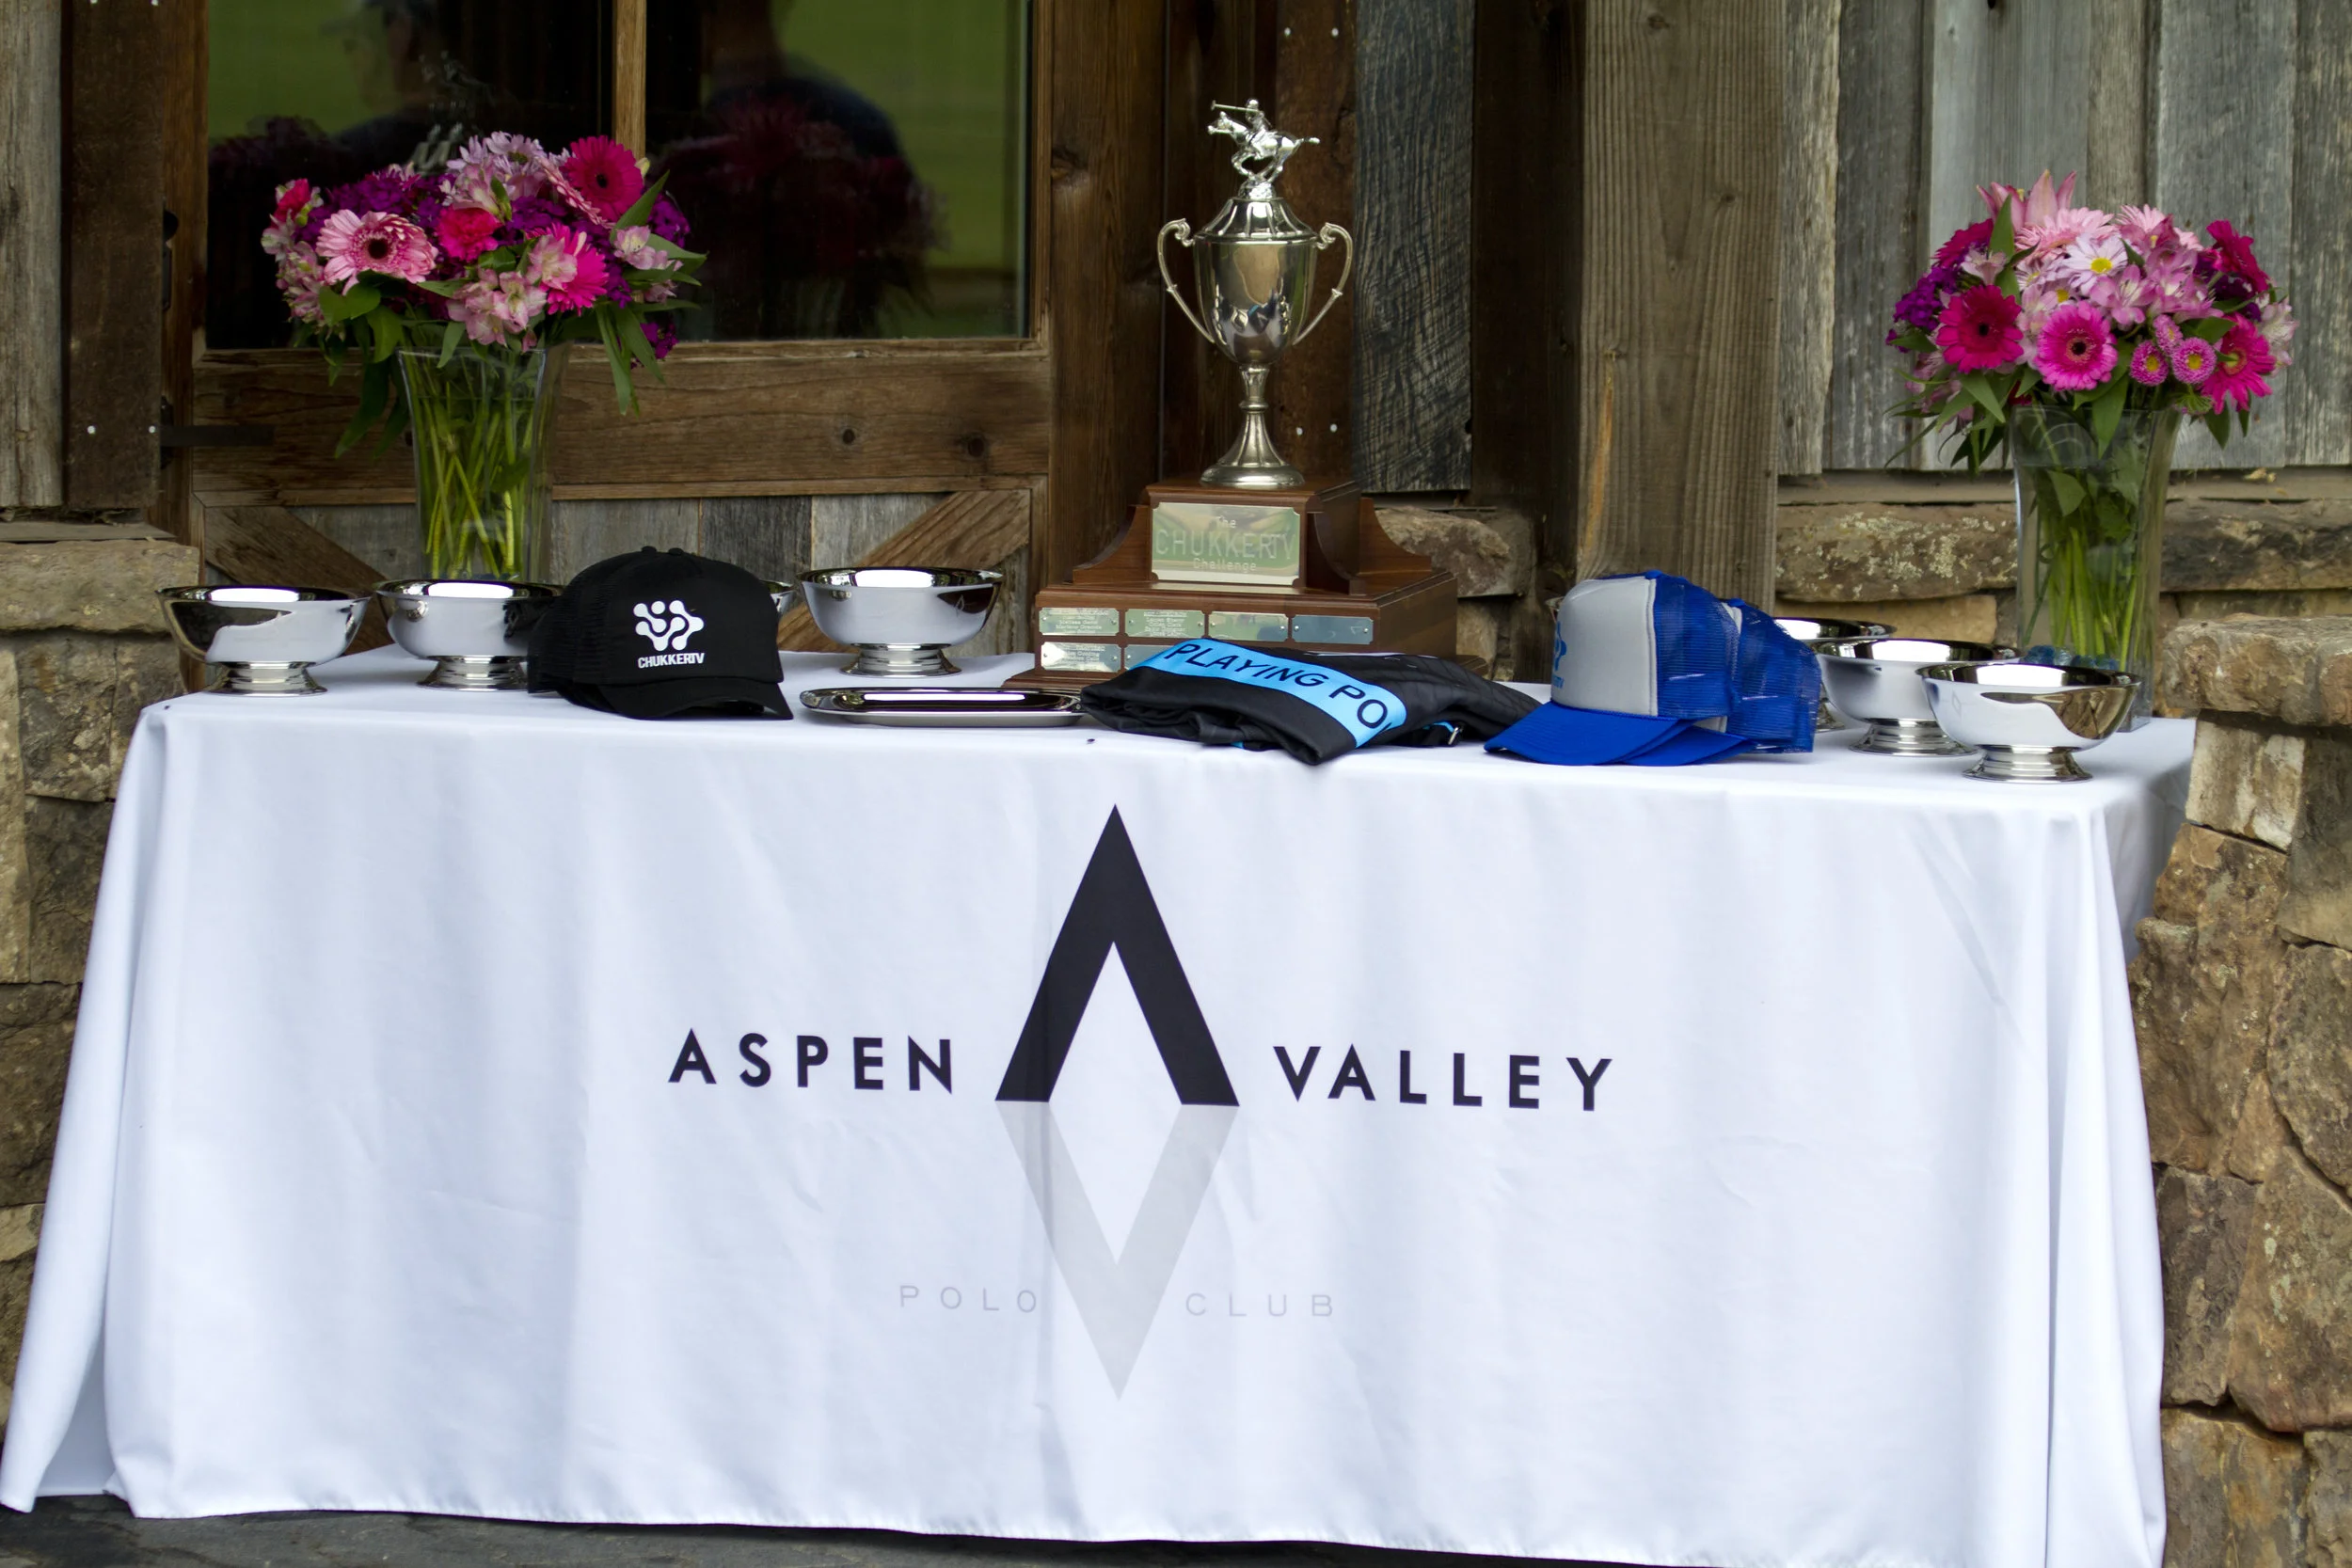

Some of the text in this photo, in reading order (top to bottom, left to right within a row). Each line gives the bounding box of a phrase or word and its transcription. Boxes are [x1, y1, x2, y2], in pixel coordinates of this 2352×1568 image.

[1216, 515, 1236, 529] The
[1192, 557, 1257, 573] Challenge
[1164, 641, 1391, 731] PLAYING PO
[669, 1028, 1613, 1112] ASPEN VALLEY
[899, 1285, 1333, 1318] POLO CLUB
